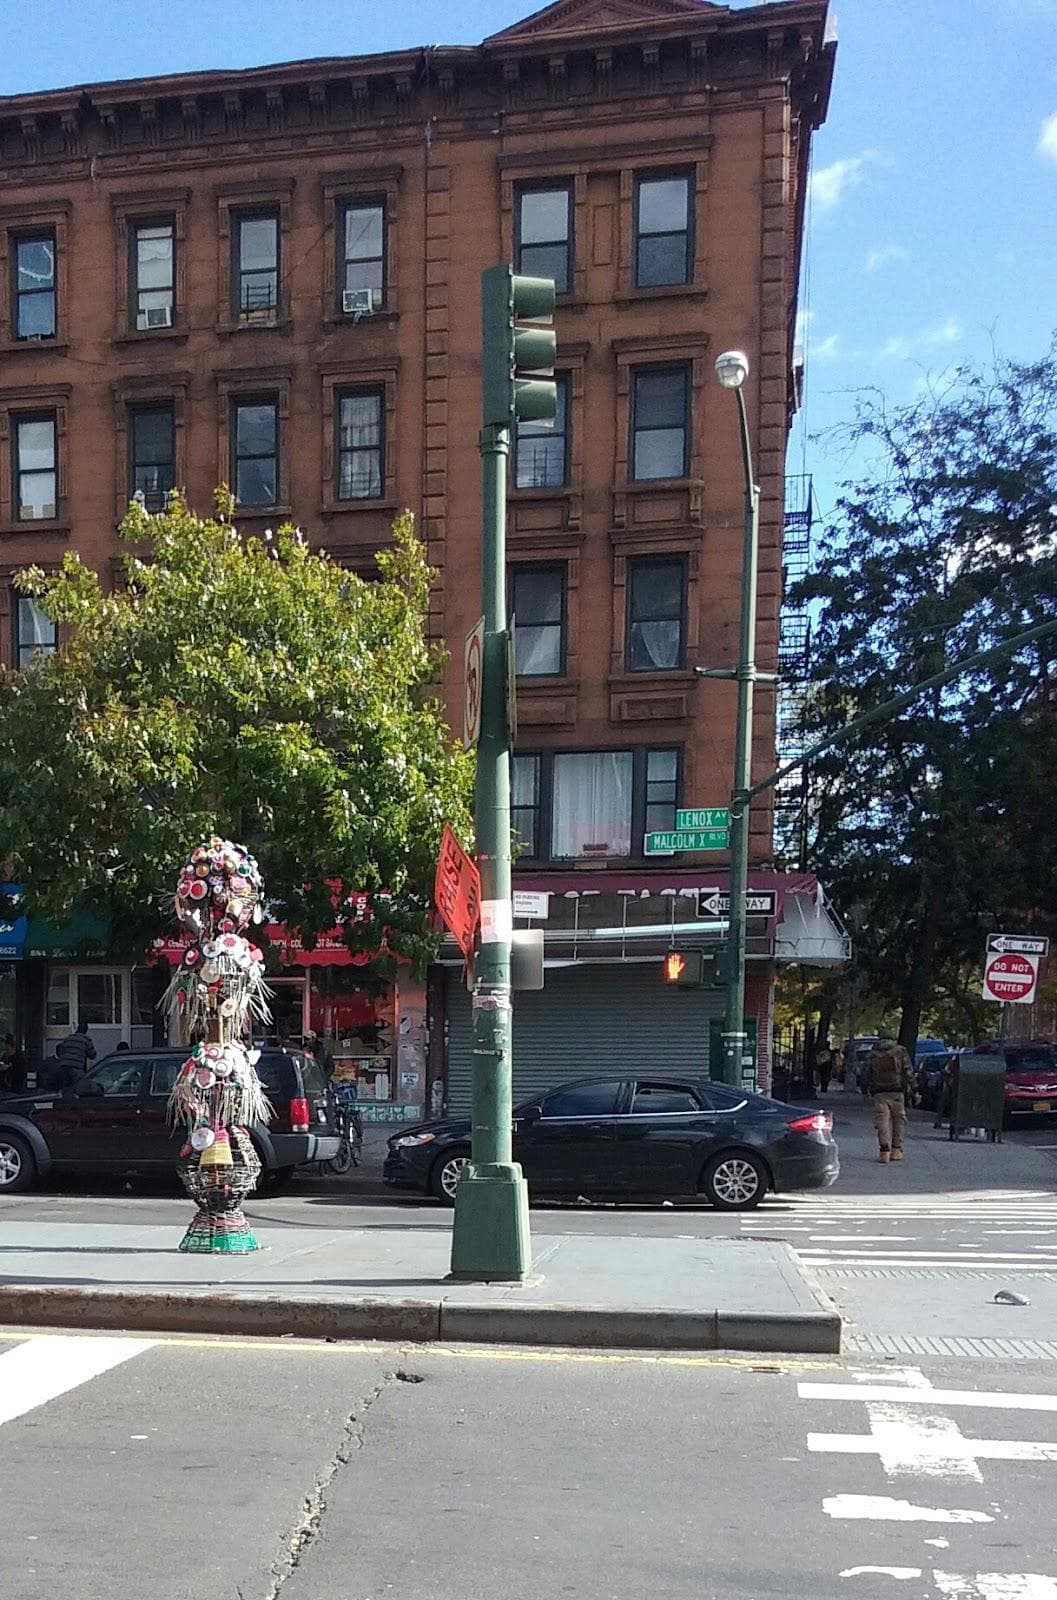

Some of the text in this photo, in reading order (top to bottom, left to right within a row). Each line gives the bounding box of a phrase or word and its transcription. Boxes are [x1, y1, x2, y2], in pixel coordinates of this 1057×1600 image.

[680, 811, 713, 827] LENOX
[653, 831, 726, 849] MALCOLM X BLVD
[439, 840, 463, 924] RAISE
[709, 900, 731, 909] ONE
[996, 941, 1014, 949] ONE
[994, 962, 1030, 973] DO NOT
[994, 982, 1024, 993] ENTER
